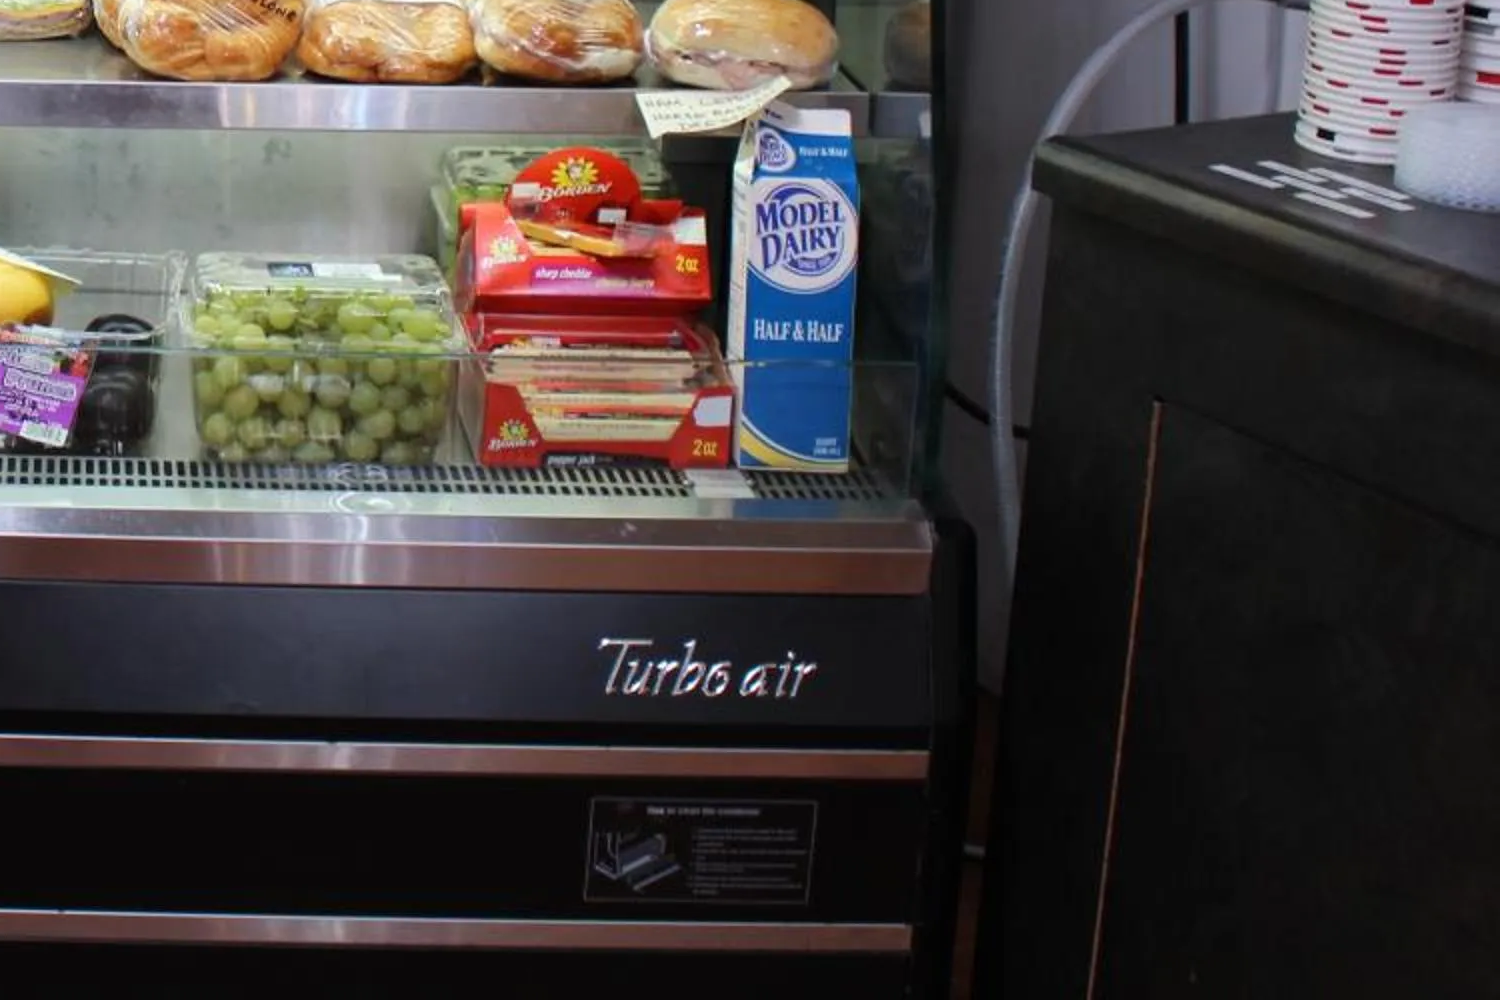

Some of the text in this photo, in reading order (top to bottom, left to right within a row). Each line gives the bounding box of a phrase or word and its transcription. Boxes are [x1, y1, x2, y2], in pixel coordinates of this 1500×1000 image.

[756, 201, 845, 235] MODEL
[762, 226, 841, 270] DAIRY
[676, 256, 686, 271] 2
[754, 318, 844, 342] HALF & HALF
[693, 439, 705, 456] 2
[598, 637, 817, 698] Turbo air
